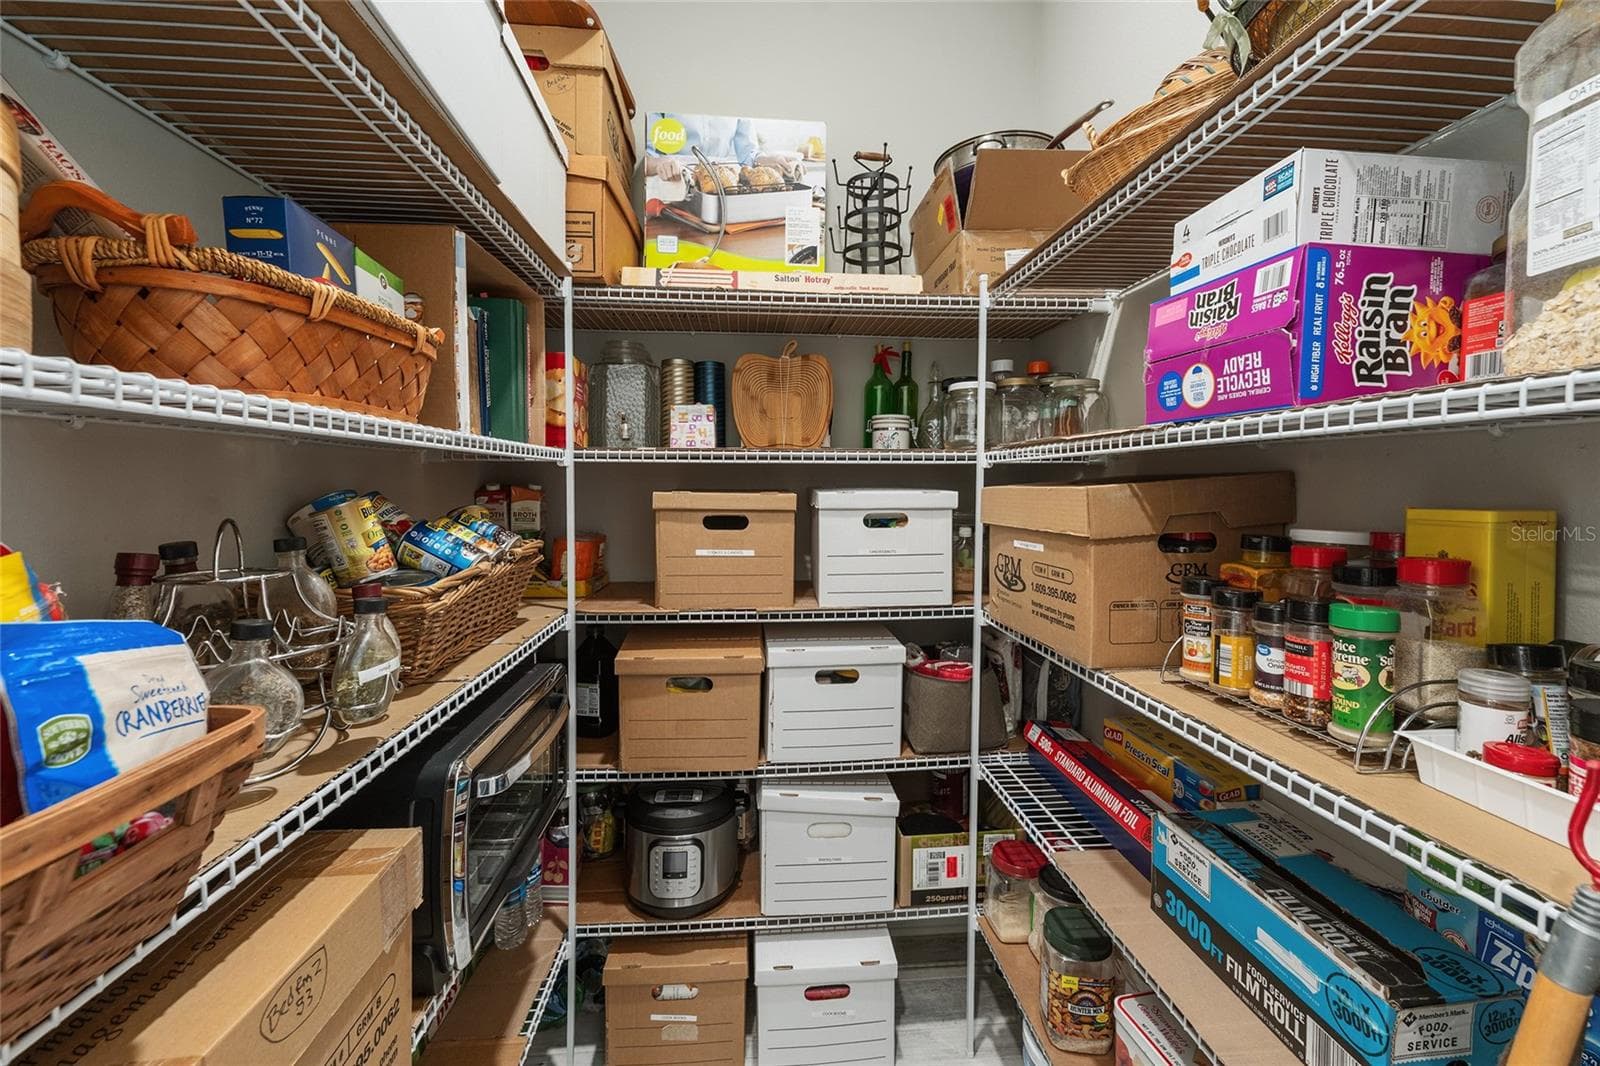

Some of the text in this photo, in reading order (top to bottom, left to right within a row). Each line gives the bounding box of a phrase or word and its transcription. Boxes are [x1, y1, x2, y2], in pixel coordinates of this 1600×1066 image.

[653, 126, 686, 148] food
[244, 205, 264, 213] PENNE
[1311, 186, 1320, 214] HERSHEY'S
[1320, 158, 1339, 241] TRIPLE CHOCOLATE
[1202, 250, 1220, 270] TRIPLE
[1221, 234, 1256, 262] CHOCOLATE
[804, 276, 832, 285] Hotray
[1334, 261, 1346, 286] 76.5
[1196, 280, 1236, 310] Bran
[1189, 295, 1240, 328] Raisin
[1310, 293, 1324, 383] HIGH FIBER REAL FRUIT
[1332, 292, 1358, 364] Kellogg's
[1354, 273, 1392, 386] Raisin
[1382, 287, 1415, 374] Bran
[1222, 350, 1262, 375] READY
[1216, 368, 1271, 394] RECYCLE
[996, 552, 1022, 578] GRM
[1170, 562, 1208, 577] GRM
[1333, 639, 1356, 653] pice
[1333, 651, 1369, 666] preme
[115, 691, 207, 737] CRANBERRIE
[1333, 694, 1360, 709] OUND
[1334, 702, 1350, 714] AGE
[1104, 728, 1123, 742] GLAD
[1150, 758, 1170, 778] Seal
[1054, 750, 1086, 782] STANDARD
[1082, 776, 1122, 814] ALUMINUM
[1120, 806, 1140, 830] FOIL
[1218, 789, 1240, 801] GLAD
[1174, 858, 1202, 886] SERVICE
[1265, 888, 1321, 922] FILM
[1420, 889, 1461, 915] Boulder
[1490, 938, 1537, 991] Zip
[1226, 953, 1260, 1002] FILM
[1263, 989, 1306, 1046] ROLL
[1246, 962, 1268, 988] FOOD
[1268, 982, 1306, 1024] SERVICE
[356, 1007, 374, 1037] GRM
[1070, 1004, 1092, 1014] HUNTER
[1418, 1009, 1449, 1021] Member's
[1418, 1022, 1448, 1036] FOOD
[1407, 1036, 1458, 1052] SERVICE
